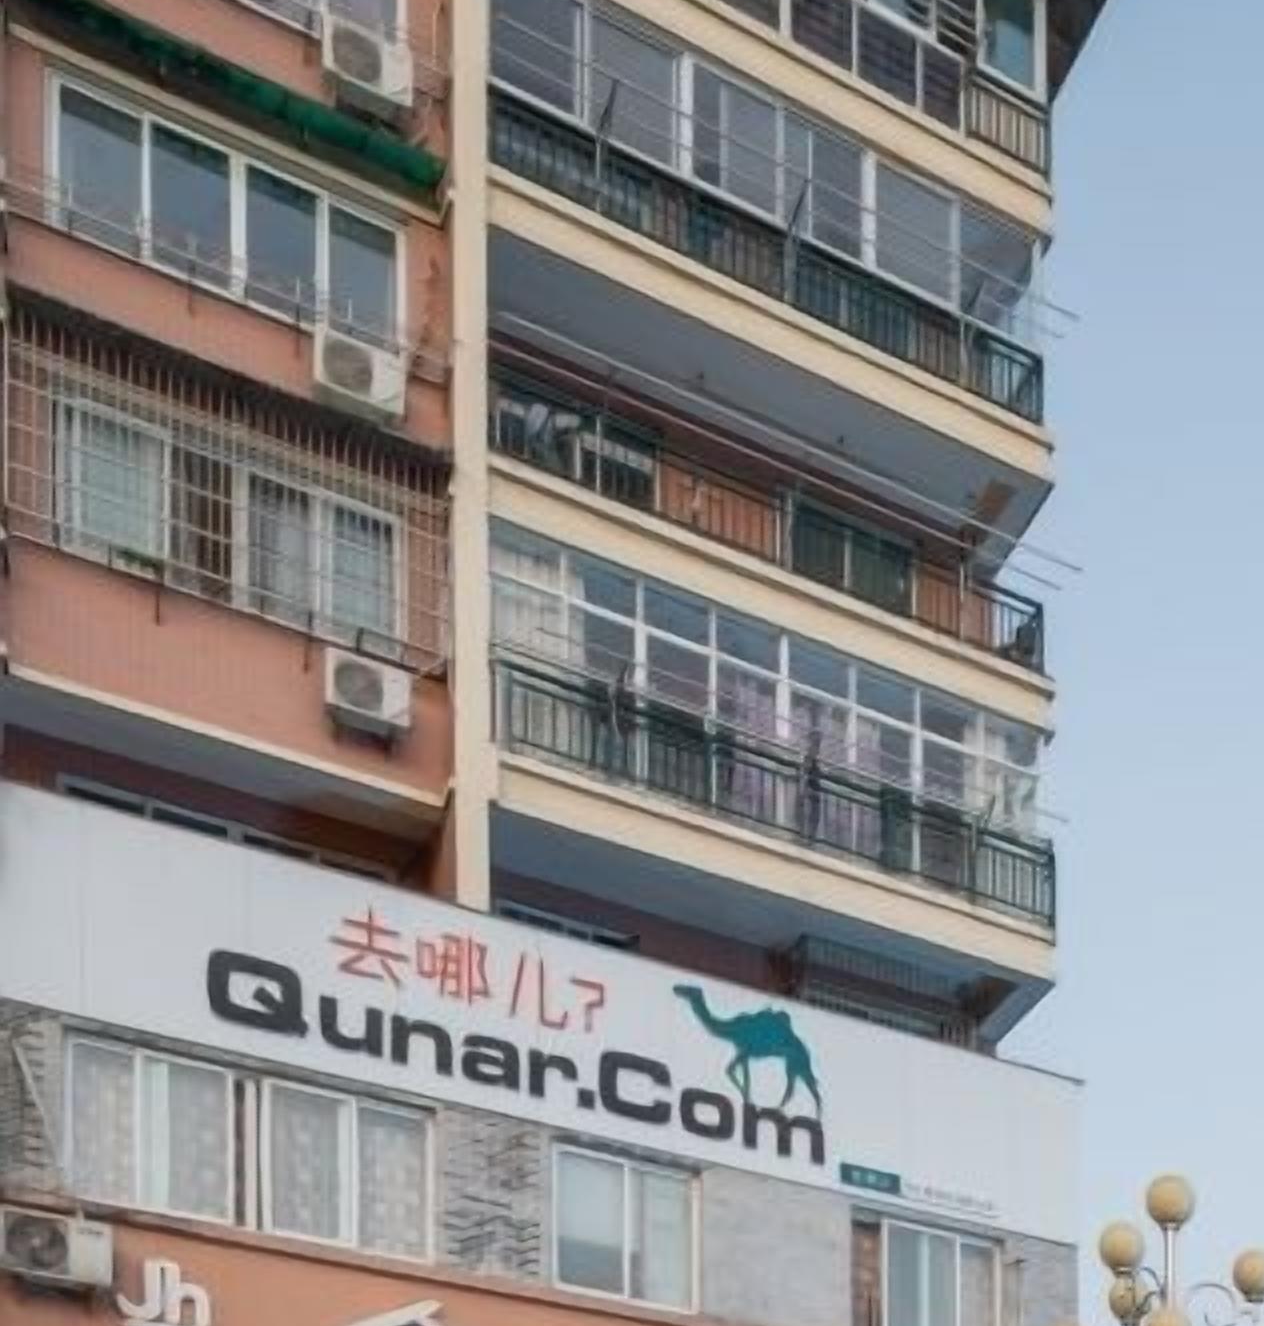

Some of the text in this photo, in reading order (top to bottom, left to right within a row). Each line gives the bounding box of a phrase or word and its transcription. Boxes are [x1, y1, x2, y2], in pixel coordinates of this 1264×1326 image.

[329, 905, 605, 1033] 去哪儿?
[206, 948, 826, 1165] Qunar.Com
